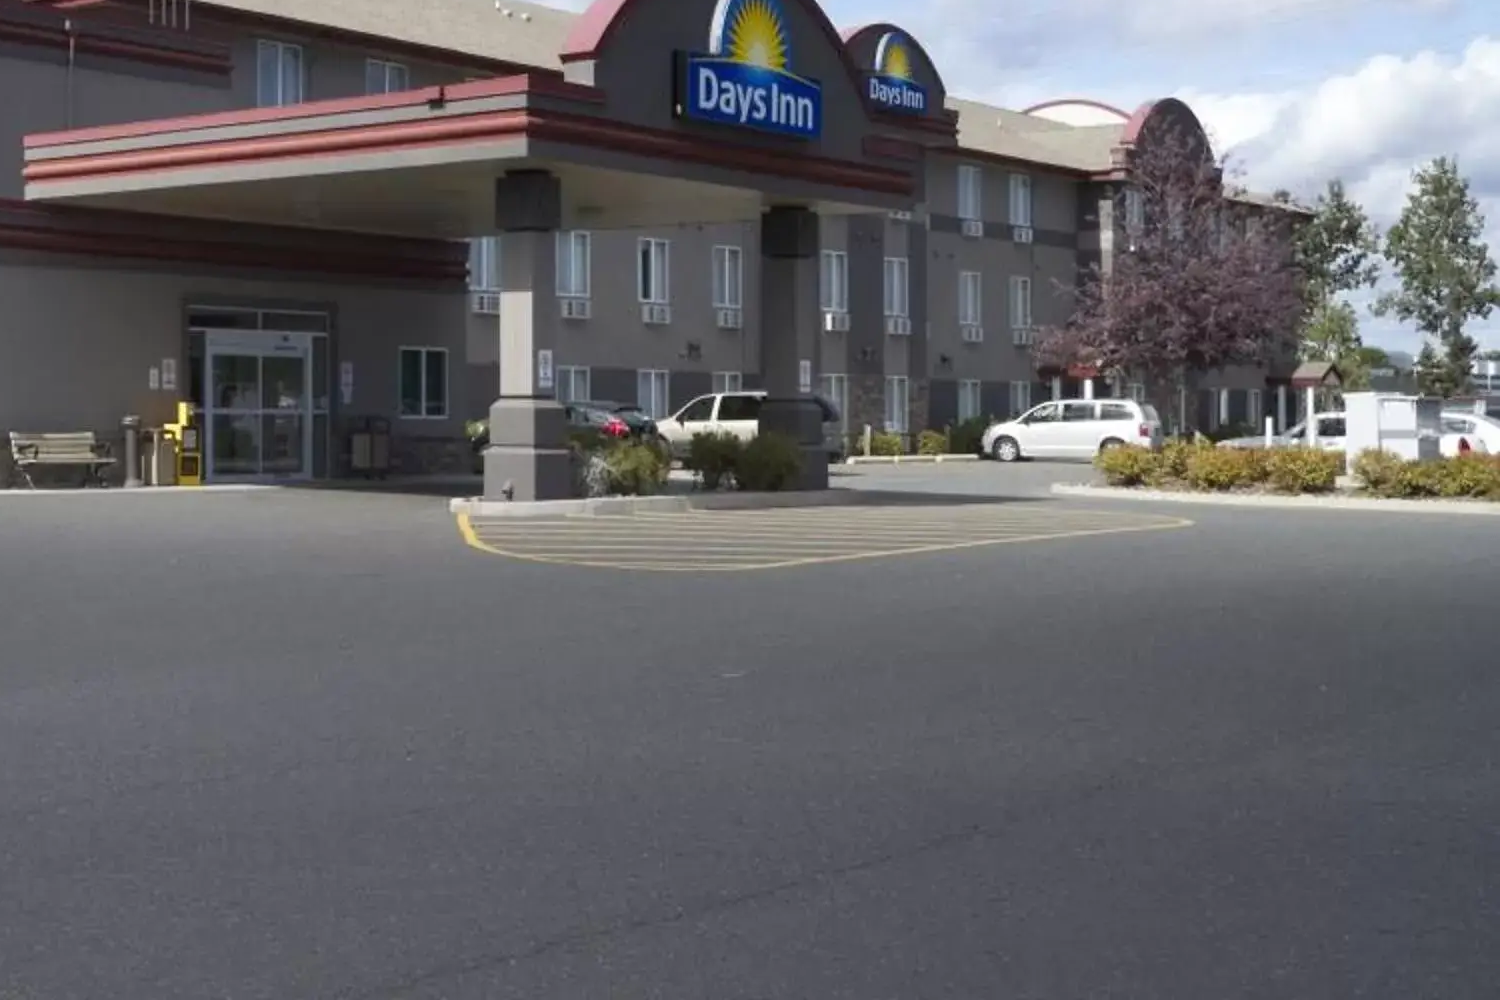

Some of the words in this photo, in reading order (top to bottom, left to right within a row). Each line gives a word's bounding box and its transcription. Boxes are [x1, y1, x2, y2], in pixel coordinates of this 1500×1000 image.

[699, 67, 767, 124] Days
[771, 83, 814, 130] Inn
[869, 78, 901, 103] Days
[902, 85, 924, 109] Inn
